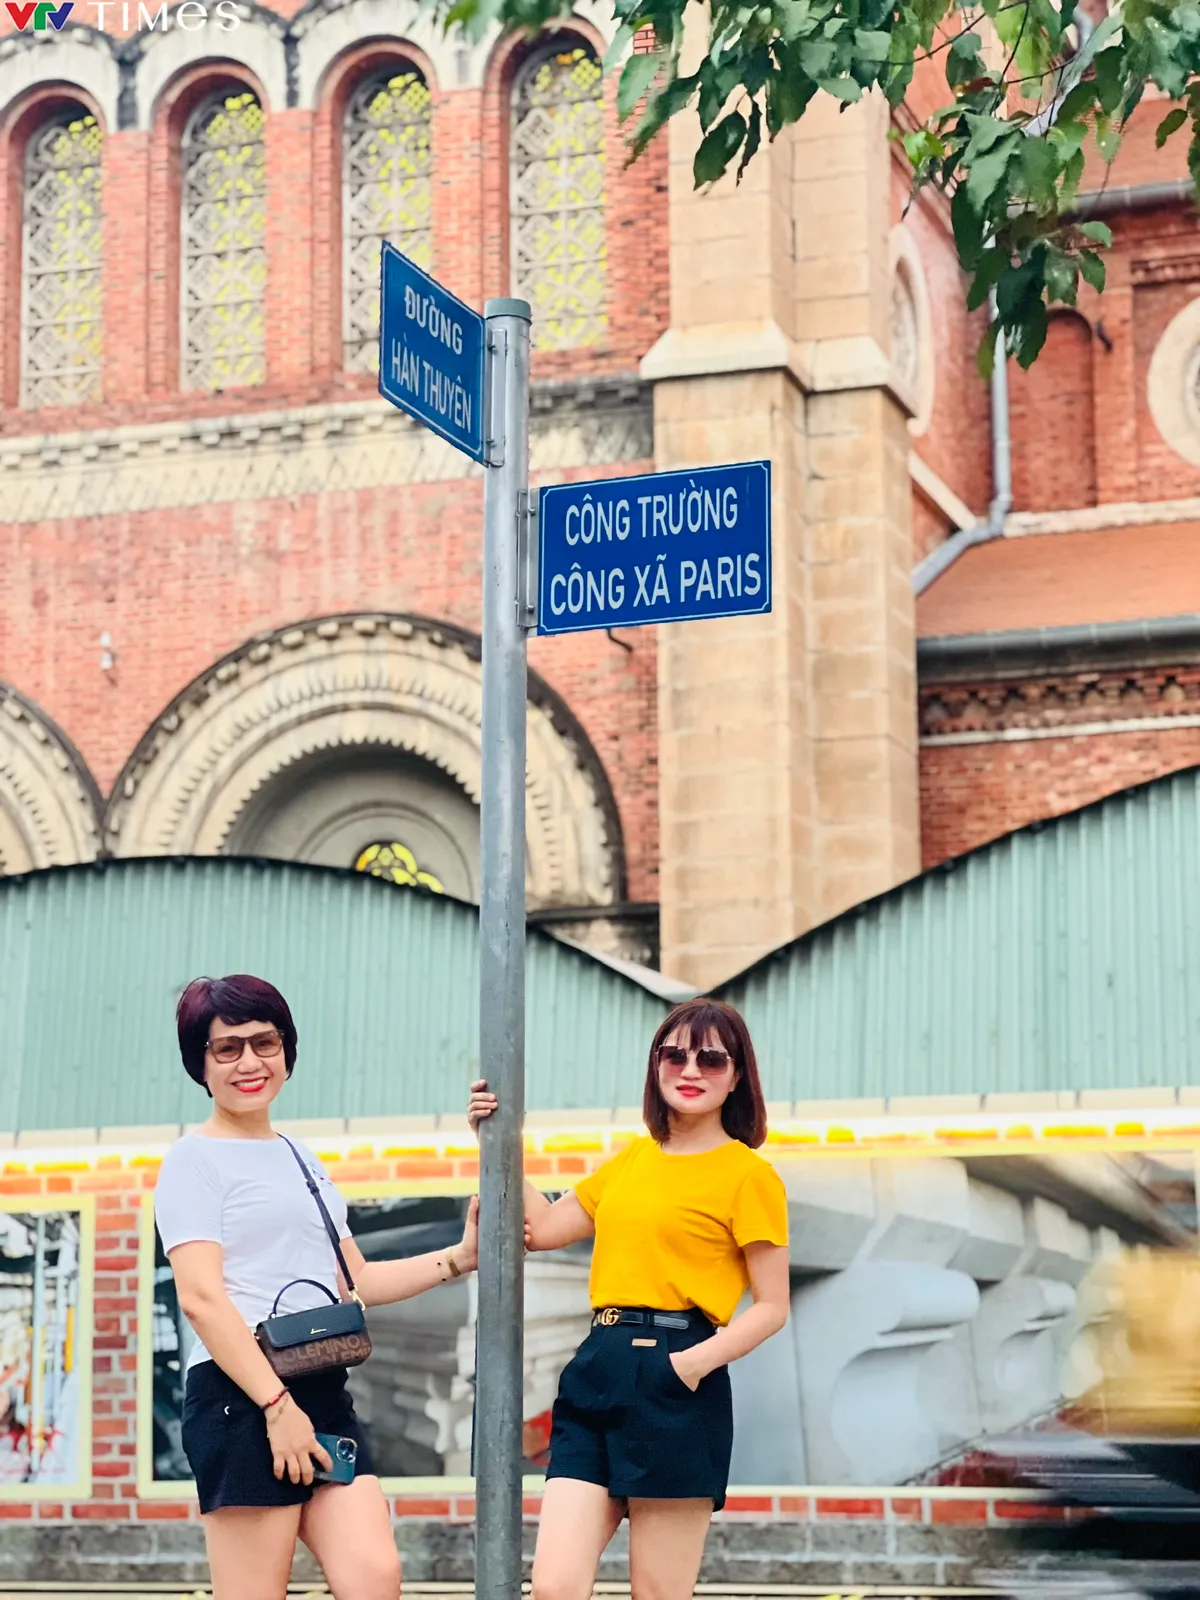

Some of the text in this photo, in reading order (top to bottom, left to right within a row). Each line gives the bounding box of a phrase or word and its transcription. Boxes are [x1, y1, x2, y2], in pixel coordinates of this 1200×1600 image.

[404, 284, 463, 355] ĐƯỜNG
[391, 333, 472, 433] HÀN THUYÊN
[565, 479, 738, 545] CÔNG TRƯỜNG
[550, 552, 761, 615] CÔNG XÃ PARIS
